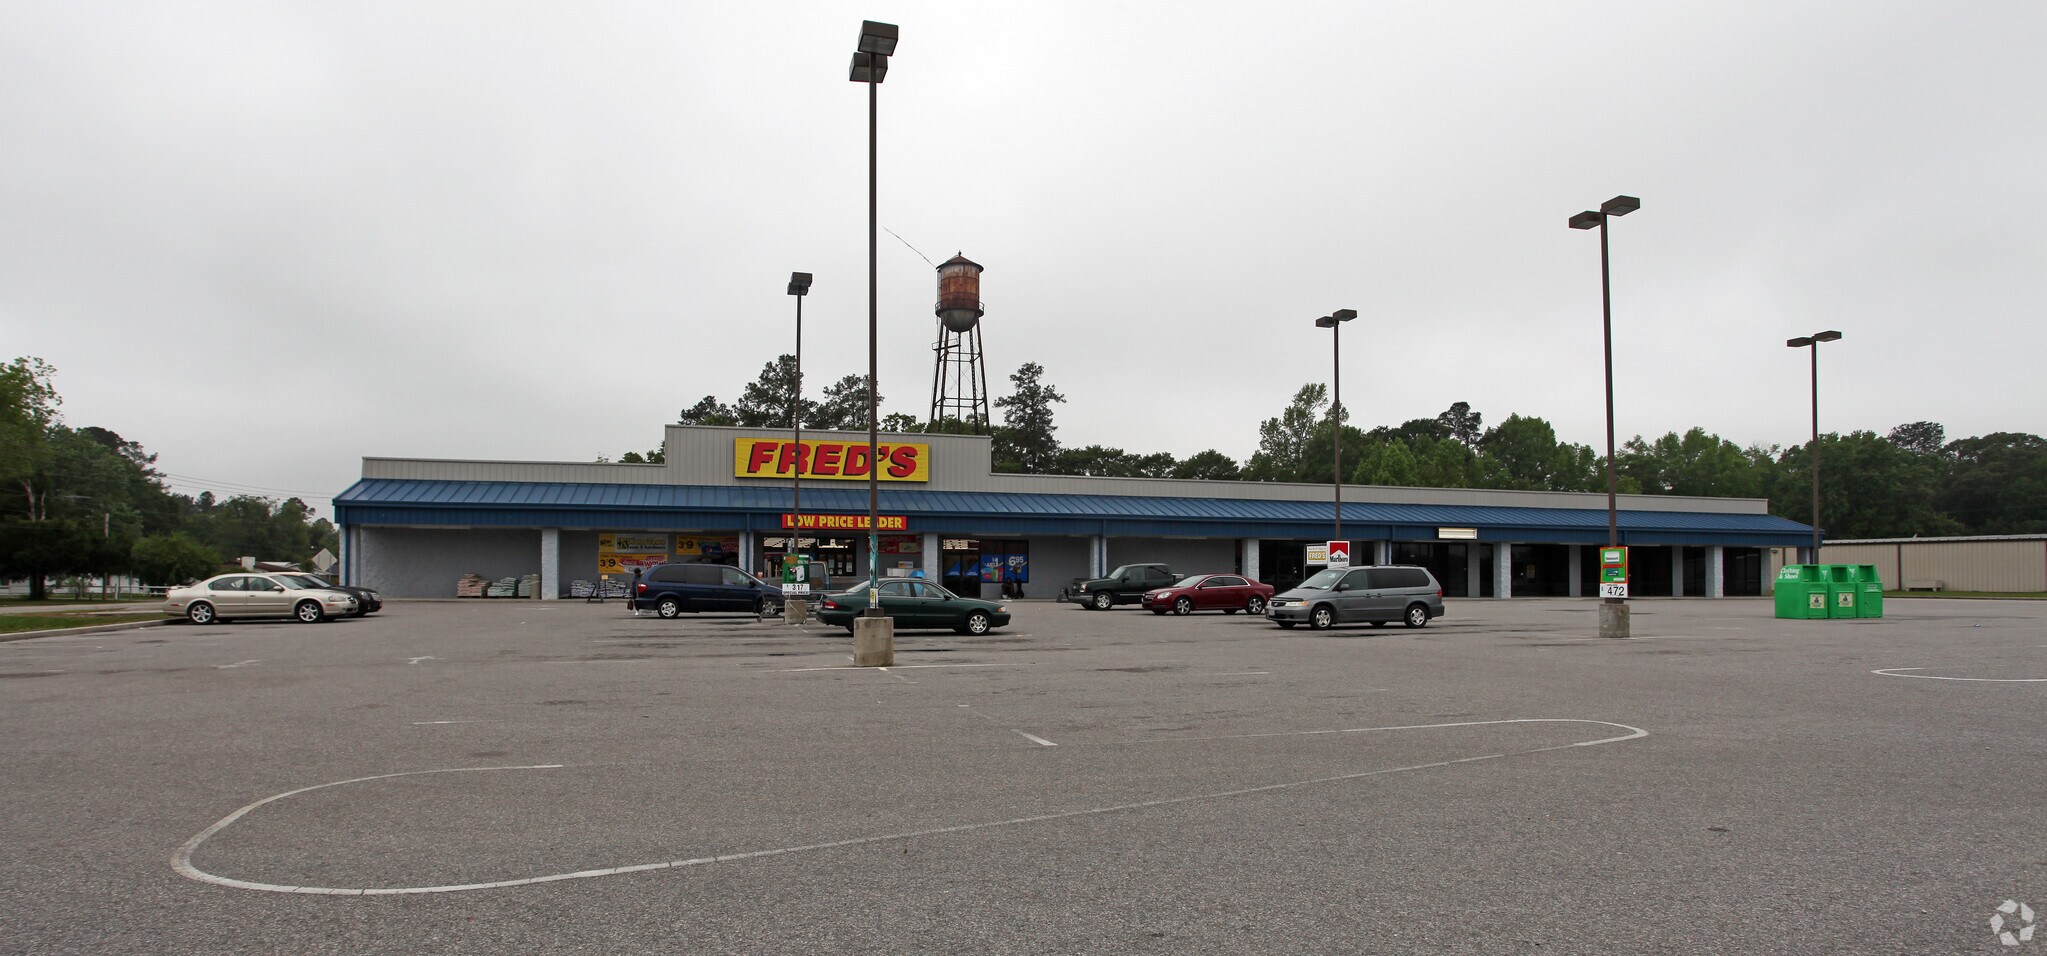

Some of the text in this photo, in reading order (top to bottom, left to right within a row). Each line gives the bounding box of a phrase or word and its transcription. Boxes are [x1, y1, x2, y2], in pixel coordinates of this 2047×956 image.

[747, 441, 919, 477] FRED'S
[787, 515, 902, 529] LOW PRICE LEDER
